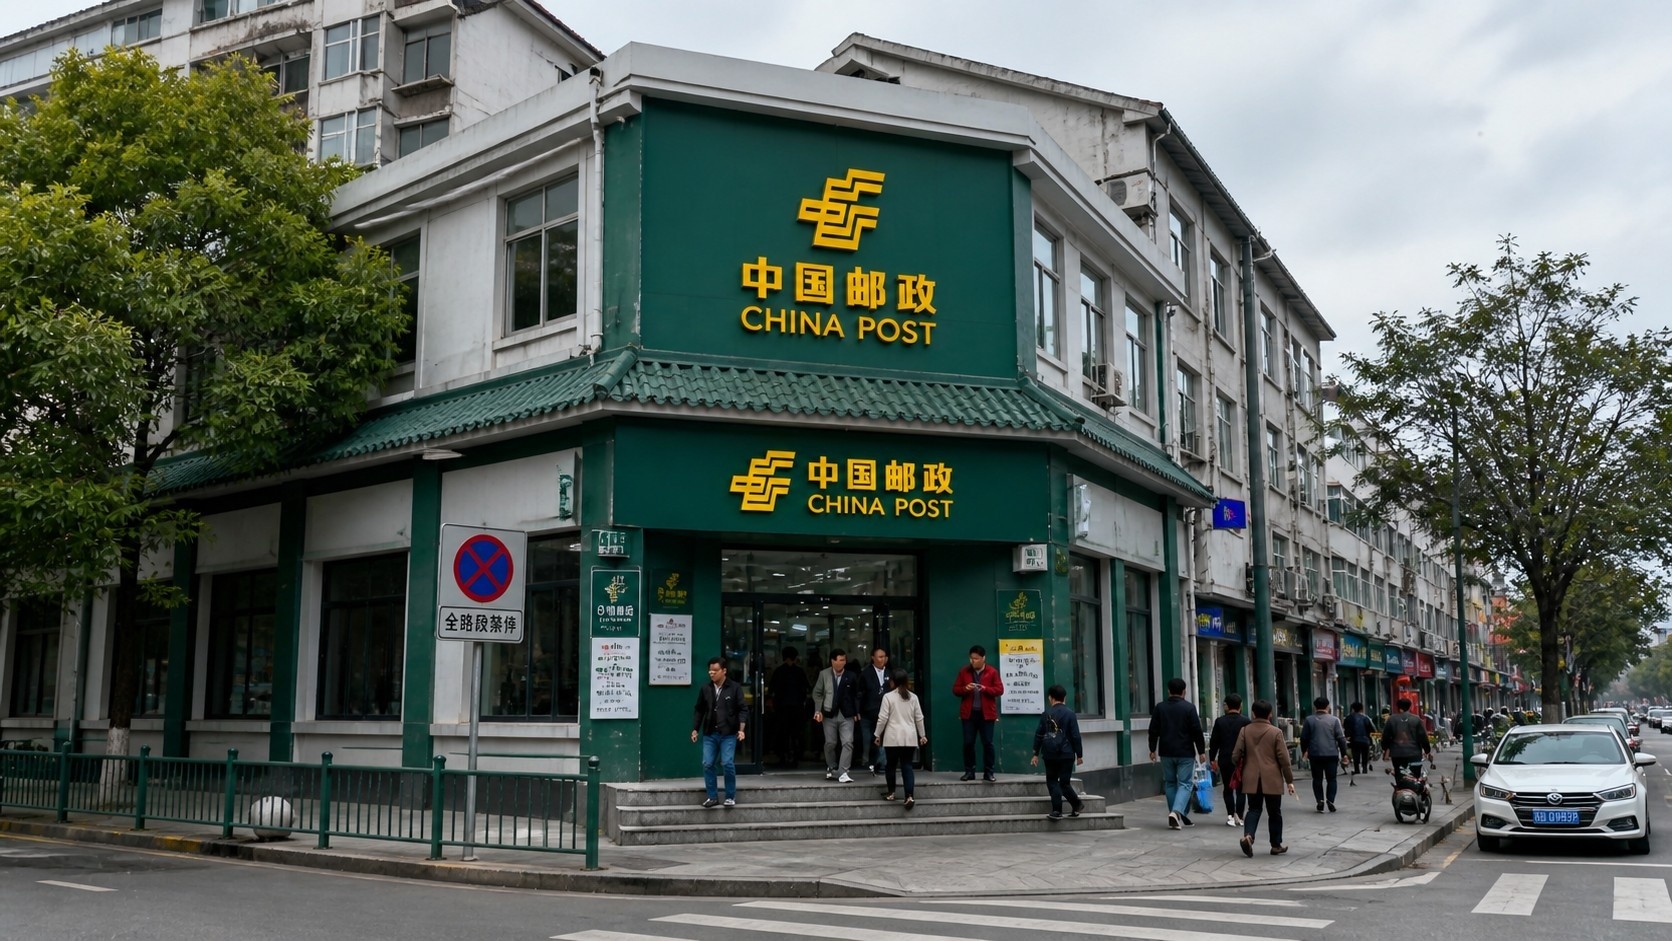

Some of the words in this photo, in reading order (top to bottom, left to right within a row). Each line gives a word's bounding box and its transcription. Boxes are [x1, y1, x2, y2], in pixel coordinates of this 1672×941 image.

[741, 256, 937, 315] 中国邮政
[740, 305, 845, 338] CHINA
[858, 315, 937, 345] POST
[808, 455, 954, 495] 中国邮政
[808, 494, 885, 516] CHINA
[895, 498, 954, 518] POST
